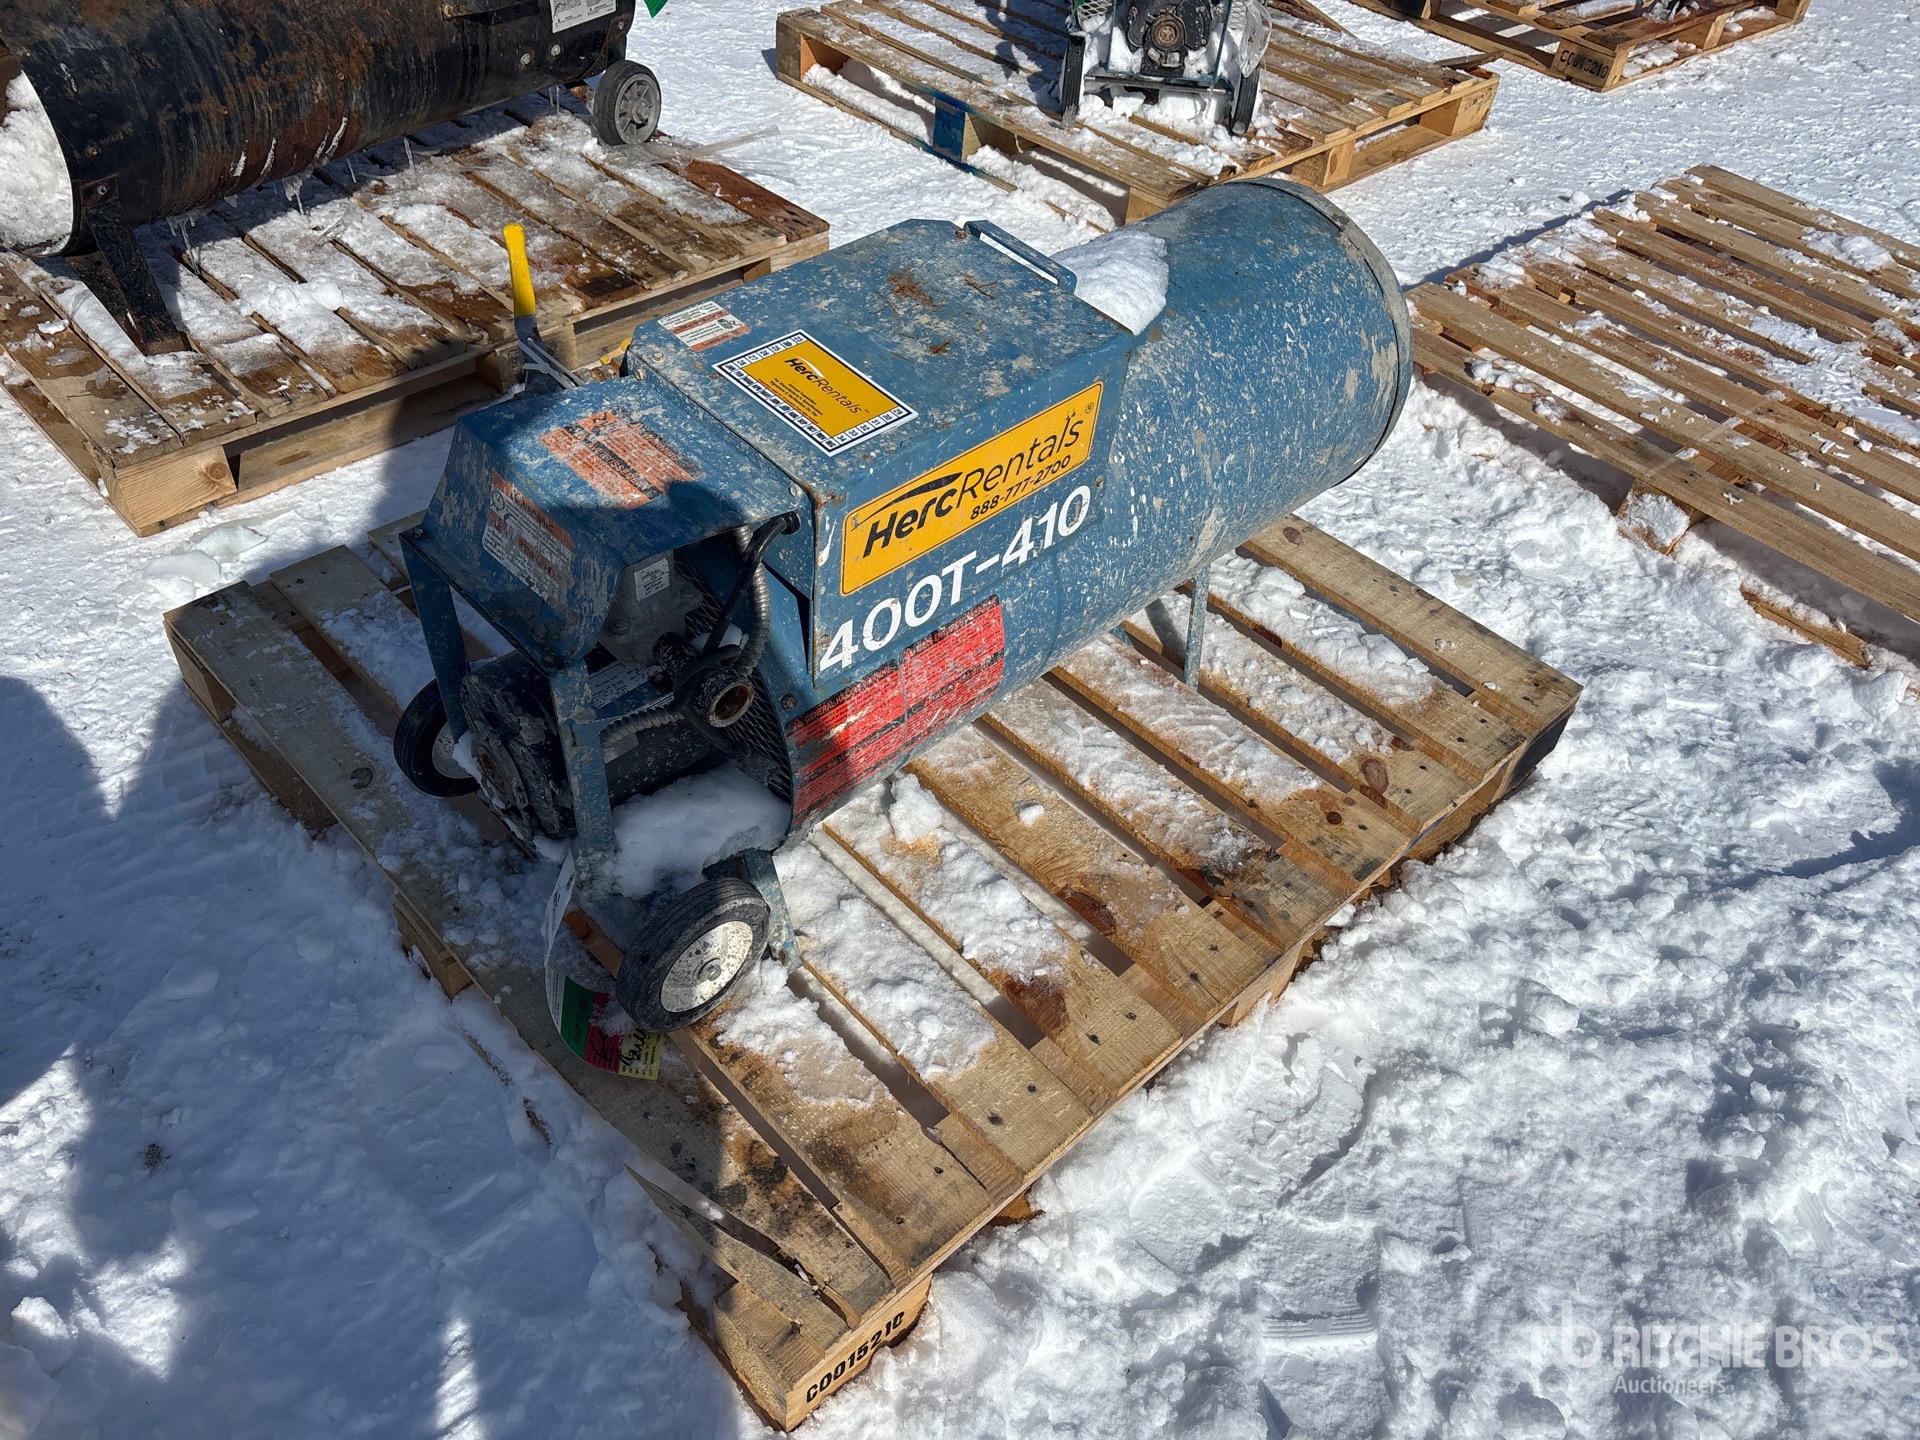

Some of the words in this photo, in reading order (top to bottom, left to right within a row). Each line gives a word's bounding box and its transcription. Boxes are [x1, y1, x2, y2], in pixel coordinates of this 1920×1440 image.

[784, 358, 862, 414] HercRentals
[863, 418, 1083, 558] HercRentals
[970, 455, 1071, 520] 888-777-2700
[819, 485, 1091, 671] 400T-410
